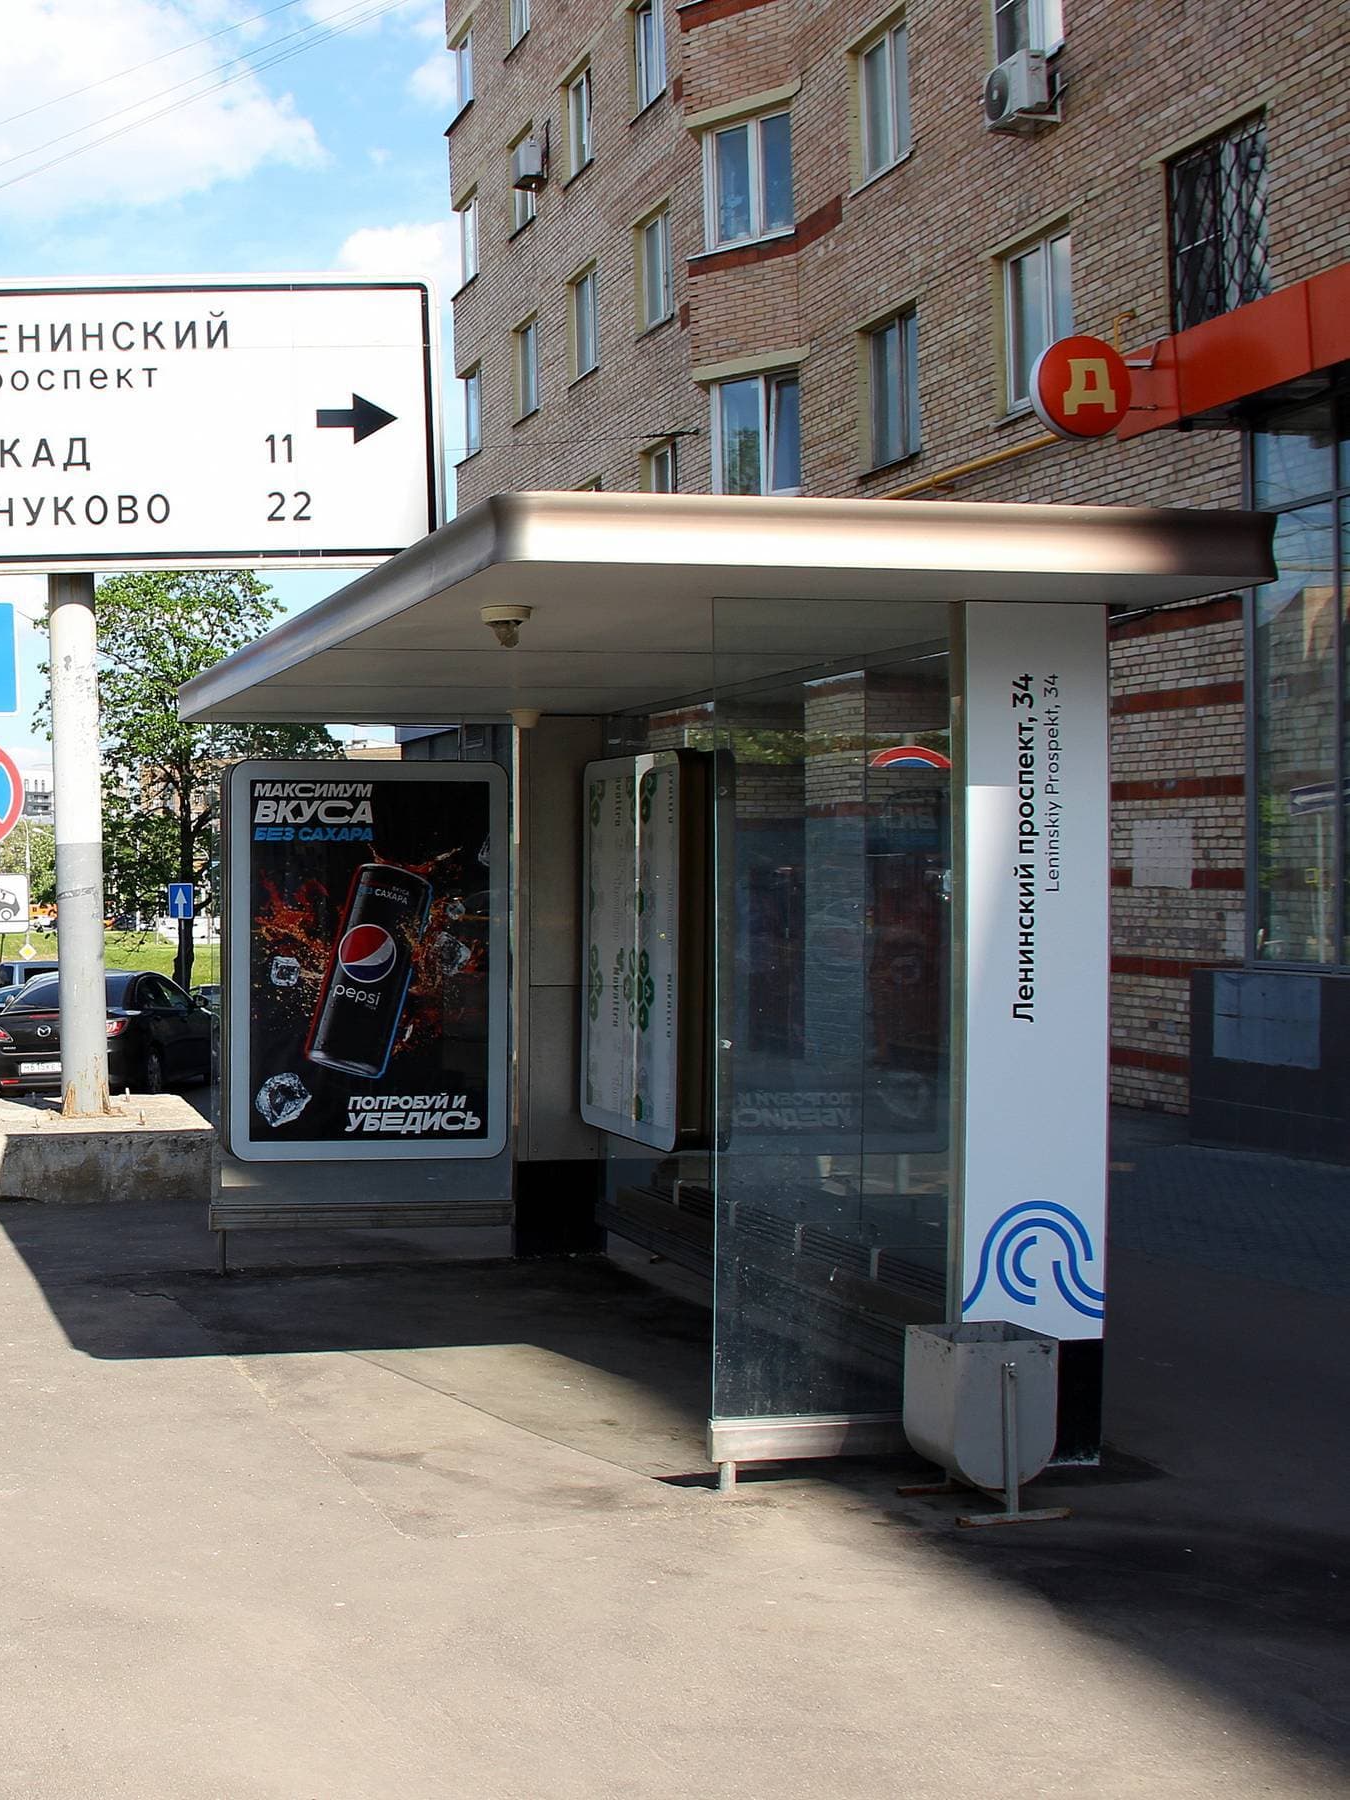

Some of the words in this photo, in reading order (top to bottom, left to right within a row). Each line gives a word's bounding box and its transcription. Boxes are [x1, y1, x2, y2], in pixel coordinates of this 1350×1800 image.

[1063, 358, 1117, 415] Д
[264, 434, 294, 463] 11
[267, 491, 312, 522] 22
[1012, 673, 1034, 709] 34
[1044, 673, 1059, 698] 34
[1043, 705, 1062, 795] Prospekt,
[253, 783, 373, 797] МАКСИМУМ
[1018, 717, 1039, 854] проспект,
[253, 800, 373, 824] ВКУСА
[254, 827, 295, 841] БЕЗ
[298, 827, 373, 841] САХАРА
[1044, 801, 1062, 892] Leninskiy
[374, 888, 408, 905] САХАРА
[1012, 863, 1035, 1023] Ленинский
[332, 984, 382, 1006] pepsi
[348, 1092, 449, 1110] ПОПРОБУЙ
[452, 1095, 467, 1109] И
[344, 1111, 481, 1134] УБЕДИСЬ
